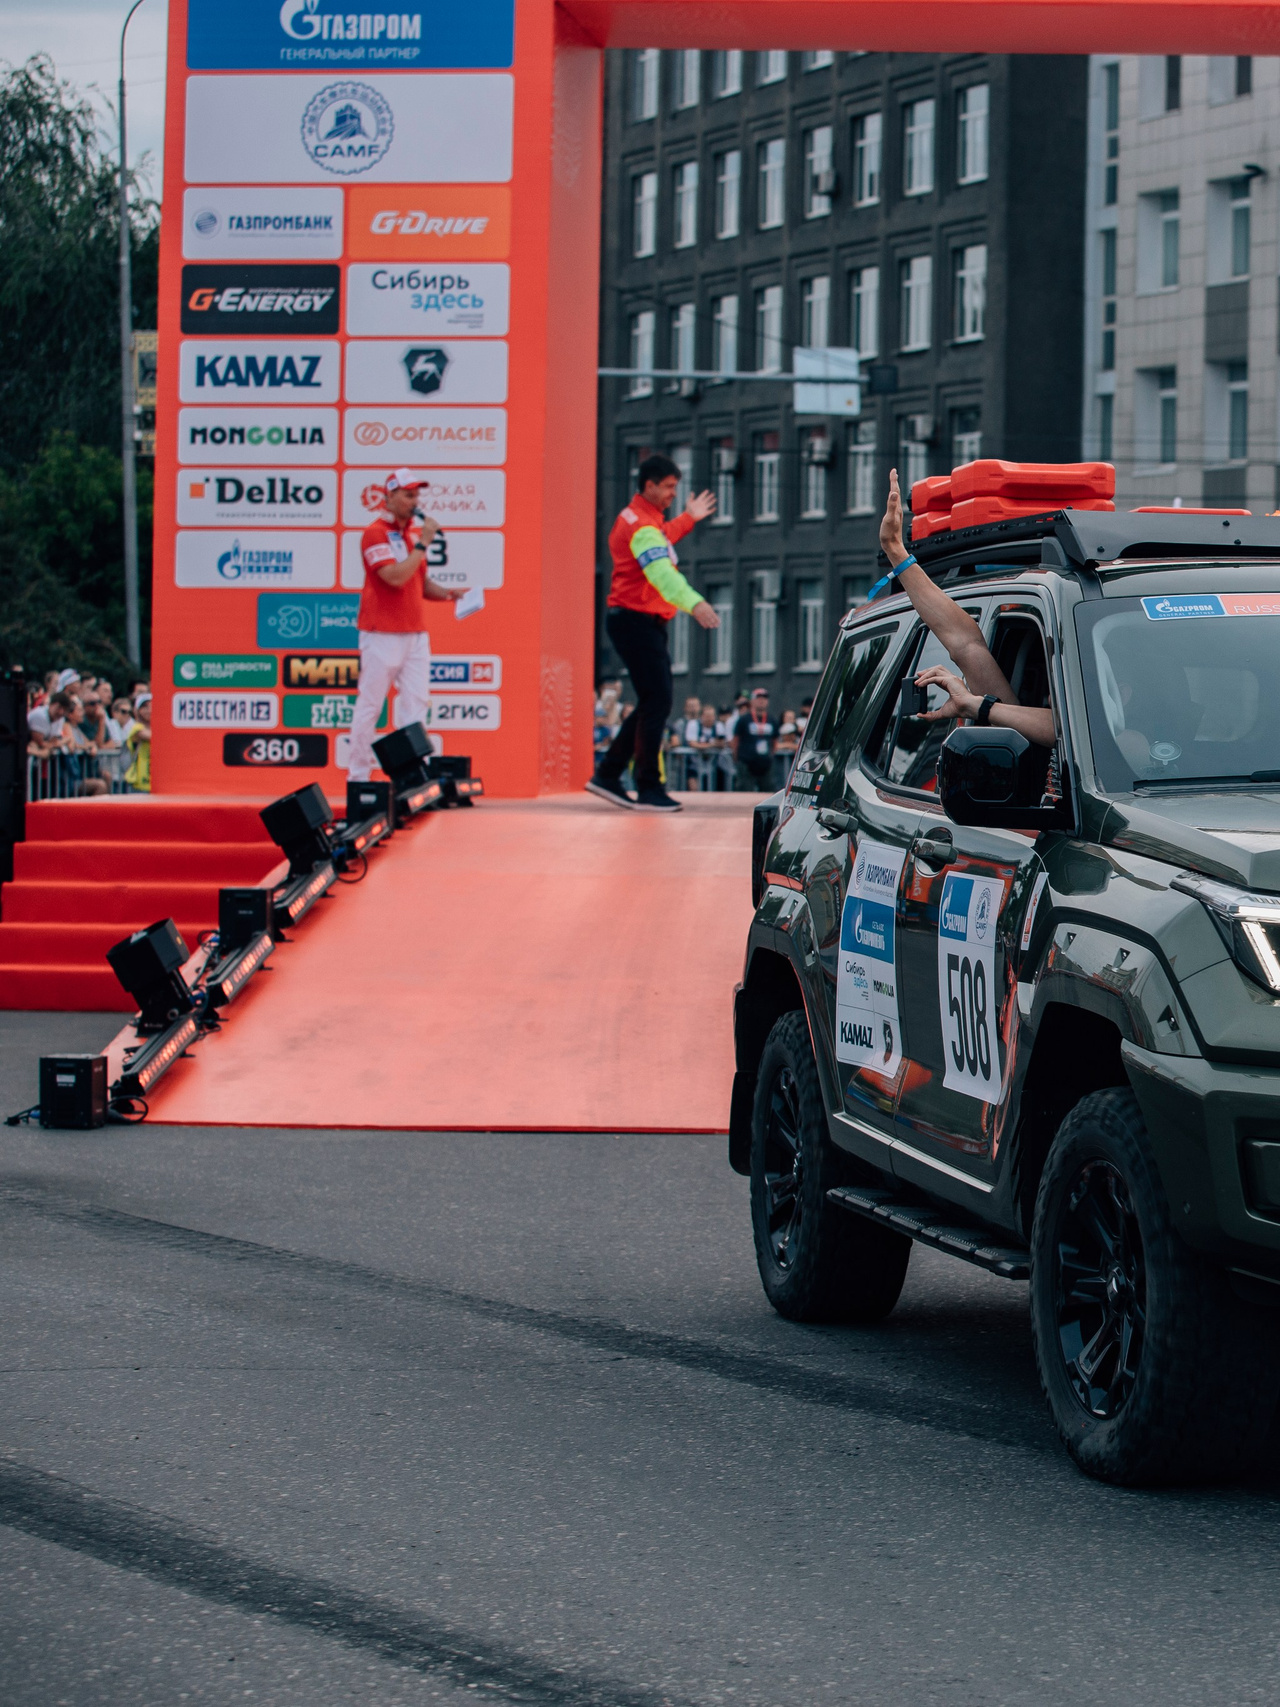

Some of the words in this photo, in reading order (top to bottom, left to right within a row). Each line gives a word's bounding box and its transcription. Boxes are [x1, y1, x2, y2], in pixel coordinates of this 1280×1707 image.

[321, 14, 422, 40] ГАЗПРОМ
[280, 46, 365, 60] ГЕНЕРАЛЬНЫЙ
[368, 46, 421, 60] ПАРТНЕР
[313, 144, 380, 158] CAMF
[228, 215, 334, 231] ГАЗПРОМБАНК
[371, 269, 470, 294] Сибирь
[410, 292, 485, 312] здесь
[195, 355, 322, 388] KAMAZ
[190, 426, 325, 445] MONGOLIA
[391, 425, 497, 442] СОГЛАСИЕ
[215, 477, 324, 504] Delko
[1172, 604, 1214, 613] GAZPROM
[201, 670, 234, 679] СПОРТ
[224, 662, 271, 672] НОВОСТИ
[474, 666, 492, 680] 24
[178, 699, 247, 721] ИЗВЕСТИЯ
[437, 704, 490, 719] 2ГИС
[251, 738, 300, 762] 360
[845, 960, 866, 979] Сибирь
[946, 952, 992, 1082] 508
[840, 1020, 874, 1049] KAMAZ
